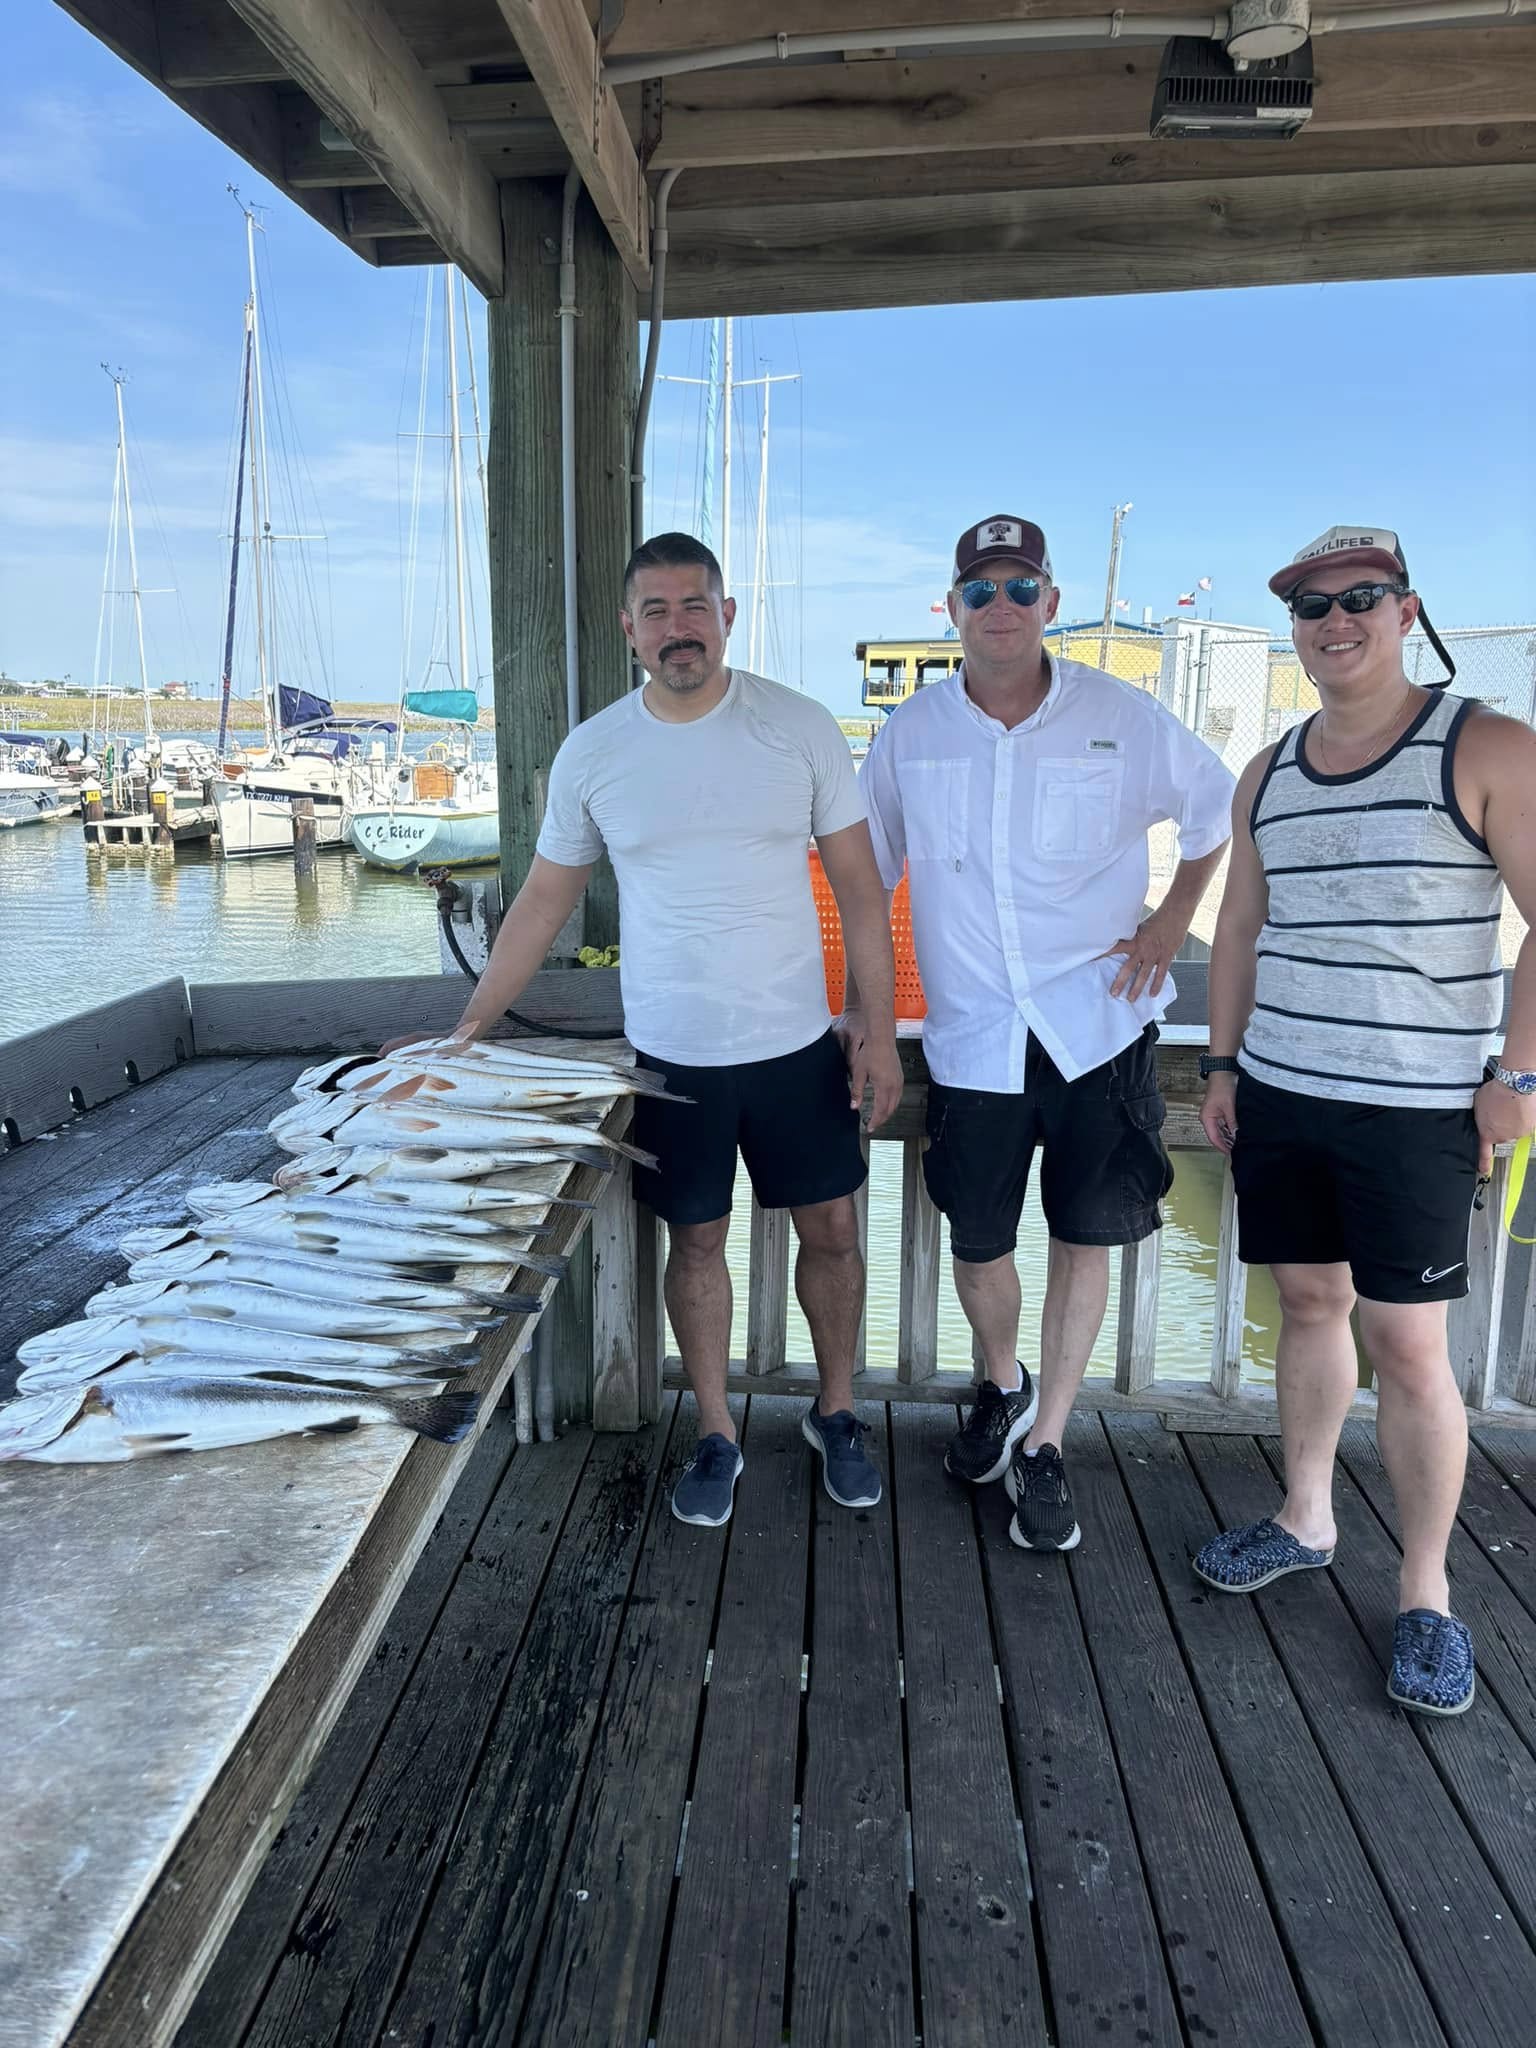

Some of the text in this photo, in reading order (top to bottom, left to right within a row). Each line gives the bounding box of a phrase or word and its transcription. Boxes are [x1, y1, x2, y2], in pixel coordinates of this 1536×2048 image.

[365, 825, 425, 838] C C Rider
